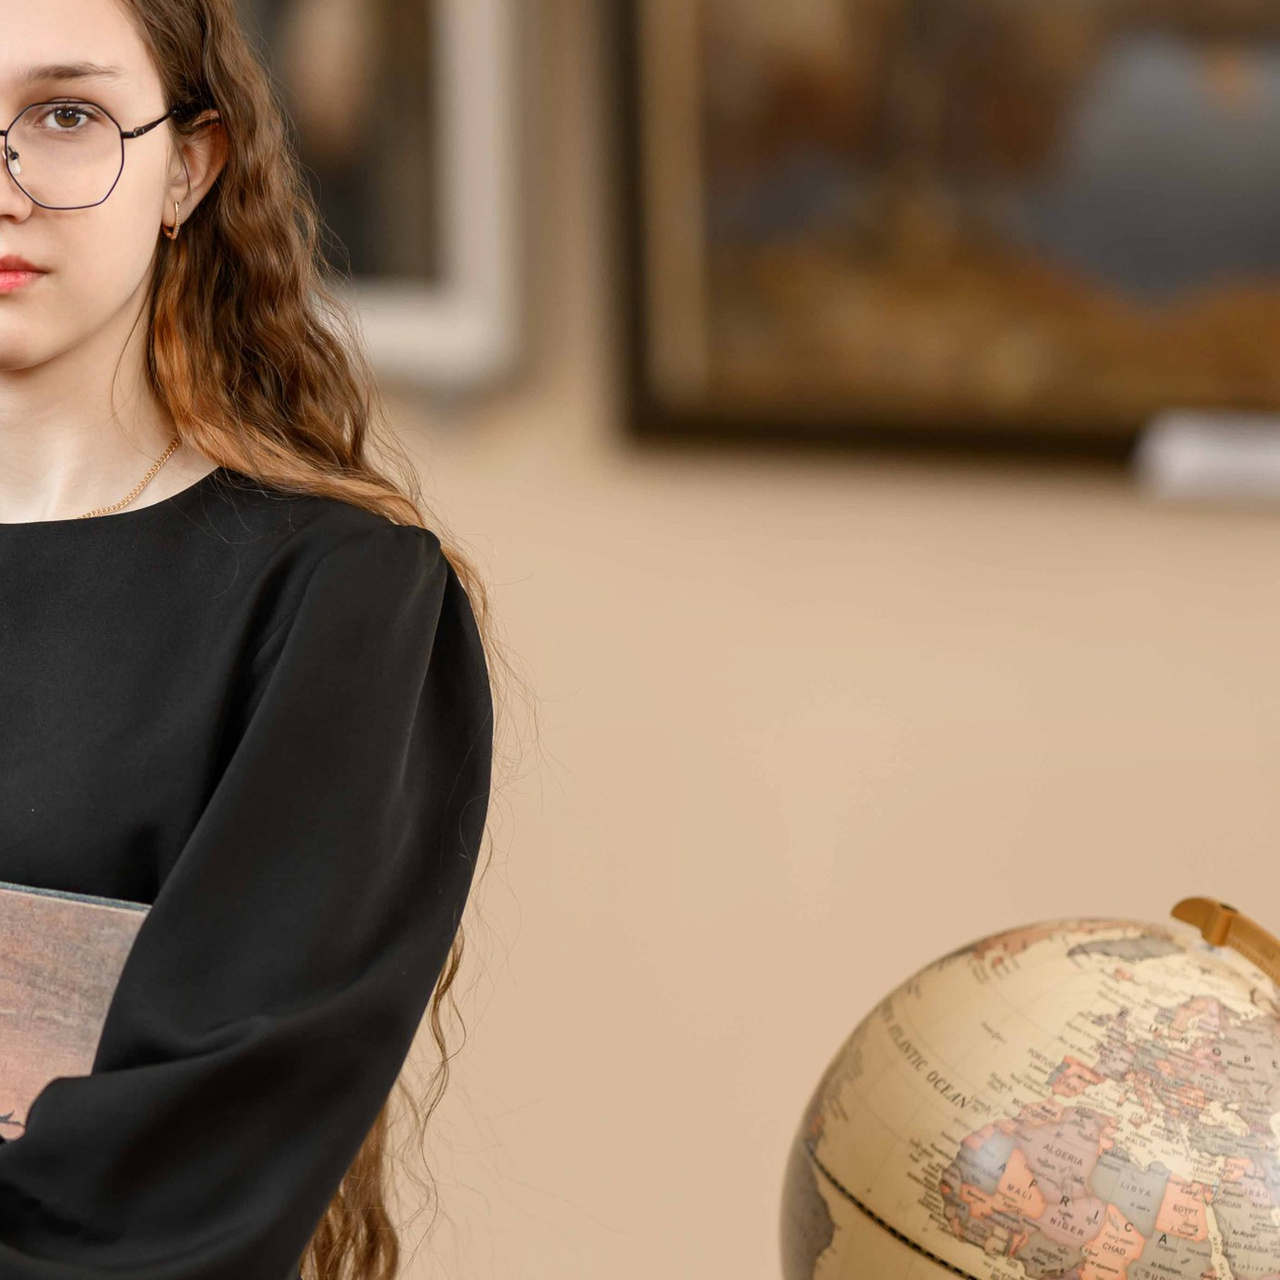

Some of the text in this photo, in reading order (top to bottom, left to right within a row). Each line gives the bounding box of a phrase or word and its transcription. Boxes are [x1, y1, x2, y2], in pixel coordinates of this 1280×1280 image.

[926, 1070, 972, 1109] OCEAN
[1043, 1143, 1084, 1166] ALGERIA
[1006, 1183, 1032, 1201] MALI
[1120, 1181, 1151, 1198] LIBYA
[1173, 1204, 1198, 1216] EGYPT
[1049, 1217, 1085, 1237] NIGER
[1102, 1242, 1126, 1256] CHAD
